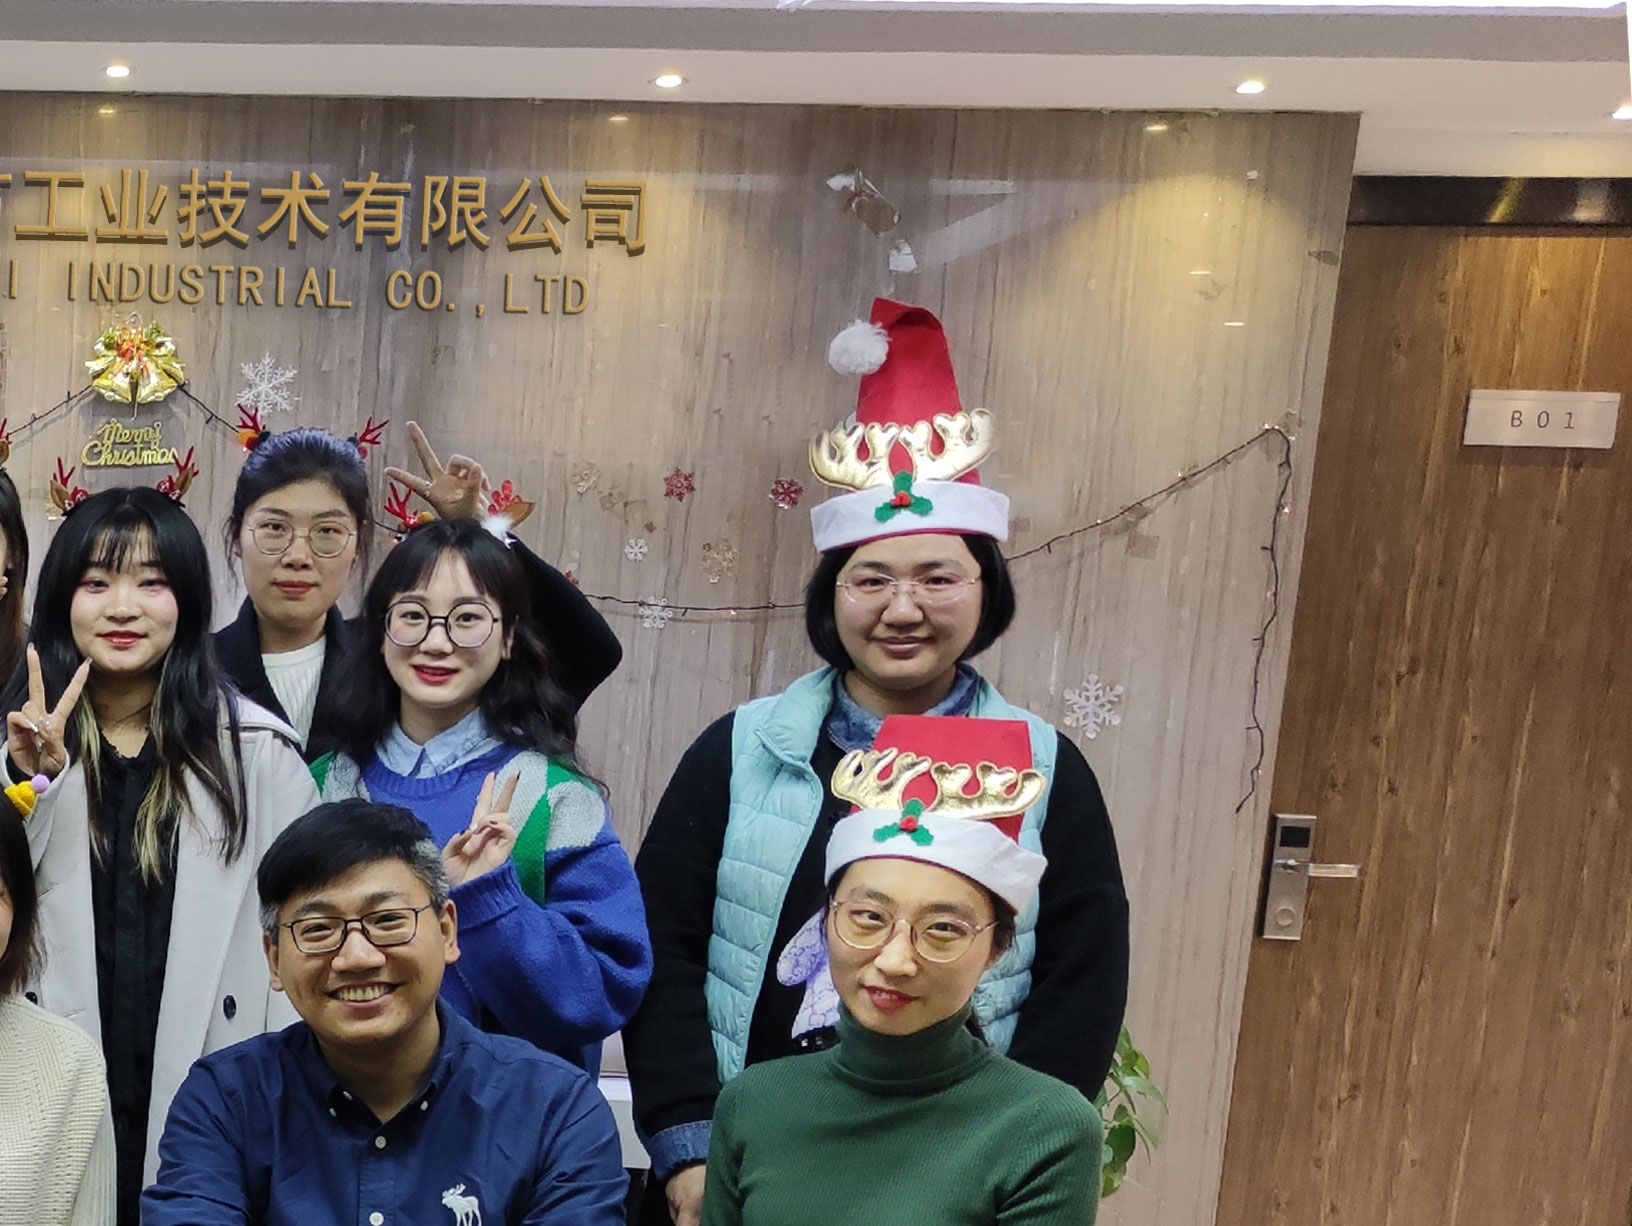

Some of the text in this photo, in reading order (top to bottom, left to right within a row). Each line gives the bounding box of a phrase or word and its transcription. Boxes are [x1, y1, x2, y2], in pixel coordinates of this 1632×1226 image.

[68, 260, 352, 309] INDUSTRIAL
[97, 418, 161, 449] Merry
[1510, 410, 1575, 430] B01
